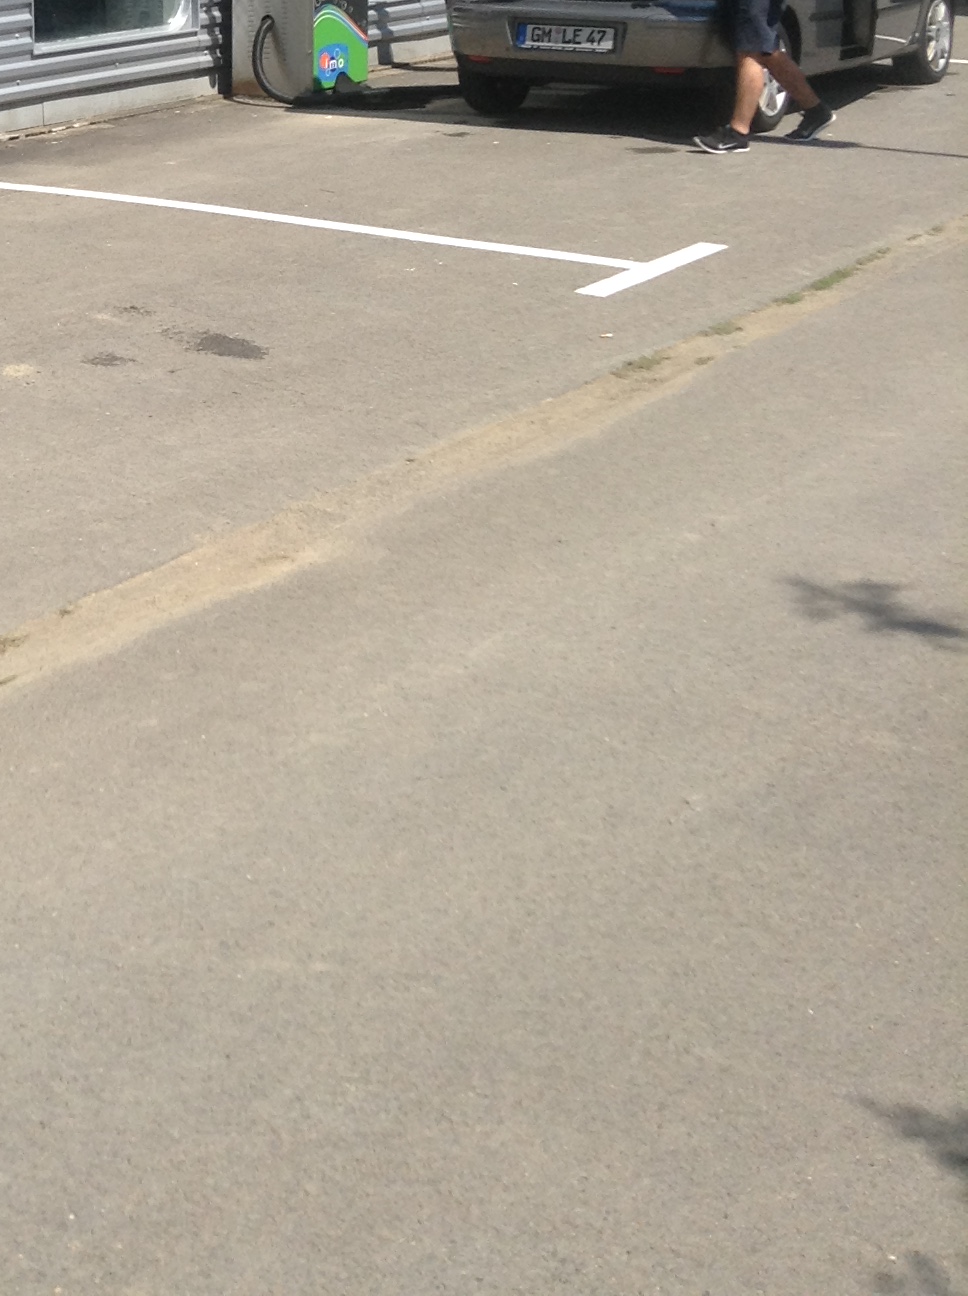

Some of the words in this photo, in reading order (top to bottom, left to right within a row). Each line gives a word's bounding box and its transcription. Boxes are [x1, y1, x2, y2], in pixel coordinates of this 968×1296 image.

[531, 26, 552, 43] GM
[561, 28, 583, 45] LE
[586, 29, 607, 46] 47
[325, 57, 344, 70] imo
